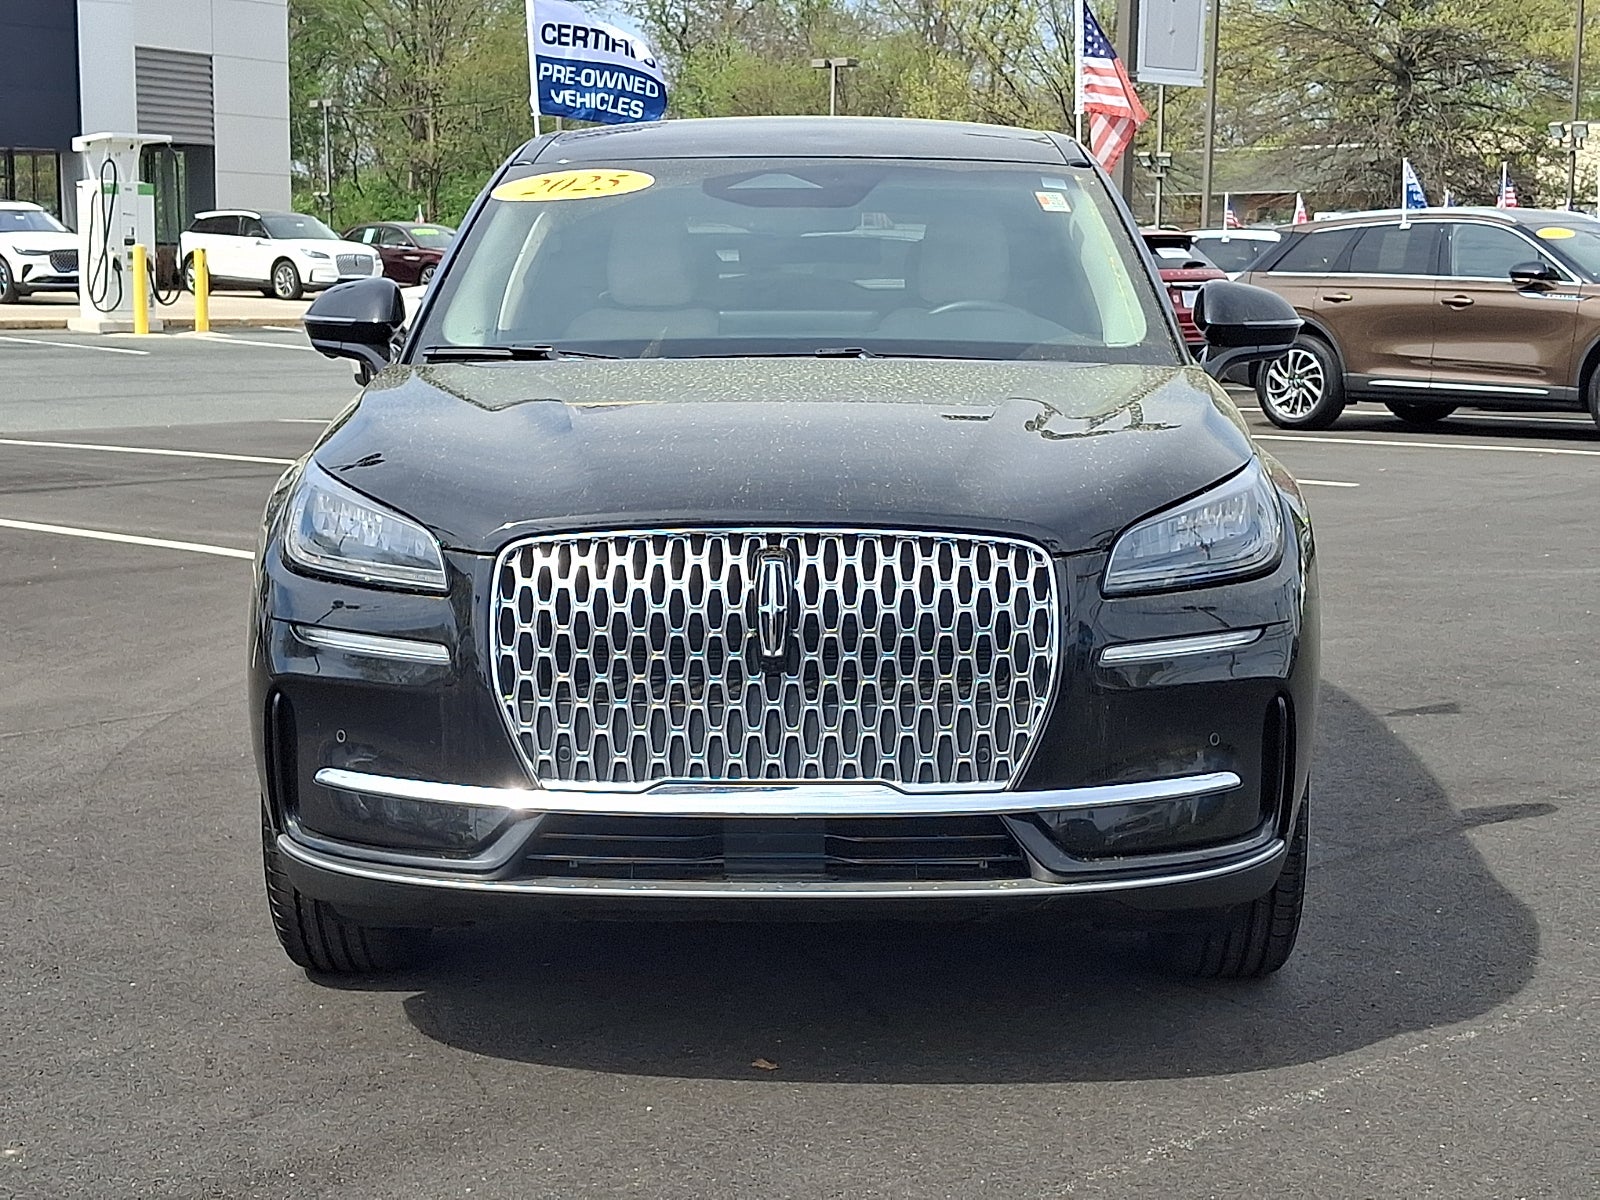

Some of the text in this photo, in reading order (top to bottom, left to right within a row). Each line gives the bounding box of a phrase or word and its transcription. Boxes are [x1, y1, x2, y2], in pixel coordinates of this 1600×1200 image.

[539, 62, 659, 98] PRE-OWNED
[550, 89, 645, 119] VEHICLES
[519, 173, 630, 196] 2025
